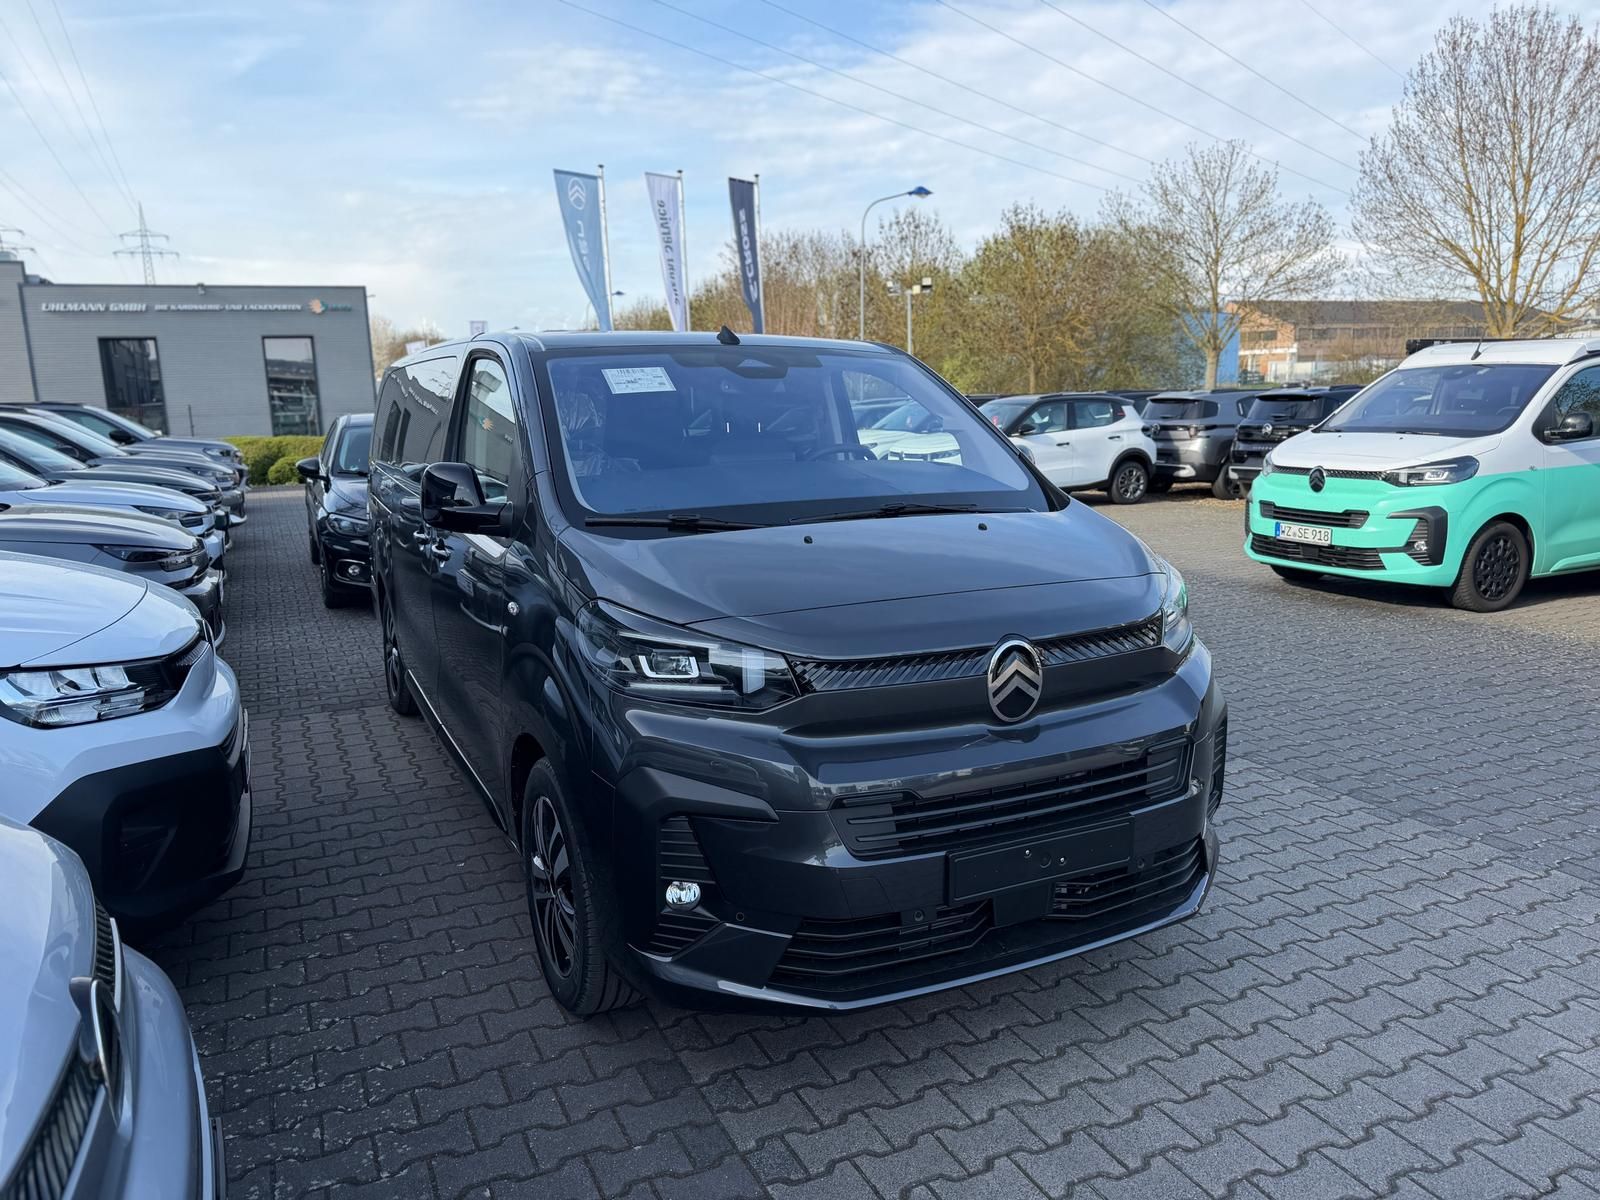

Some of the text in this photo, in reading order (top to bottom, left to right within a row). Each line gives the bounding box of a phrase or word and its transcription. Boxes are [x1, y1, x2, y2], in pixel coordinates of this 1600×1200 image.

[41, 303, 106, 312] UHLMANN
[1280, 525, 1329, 541] WZ SE 918
